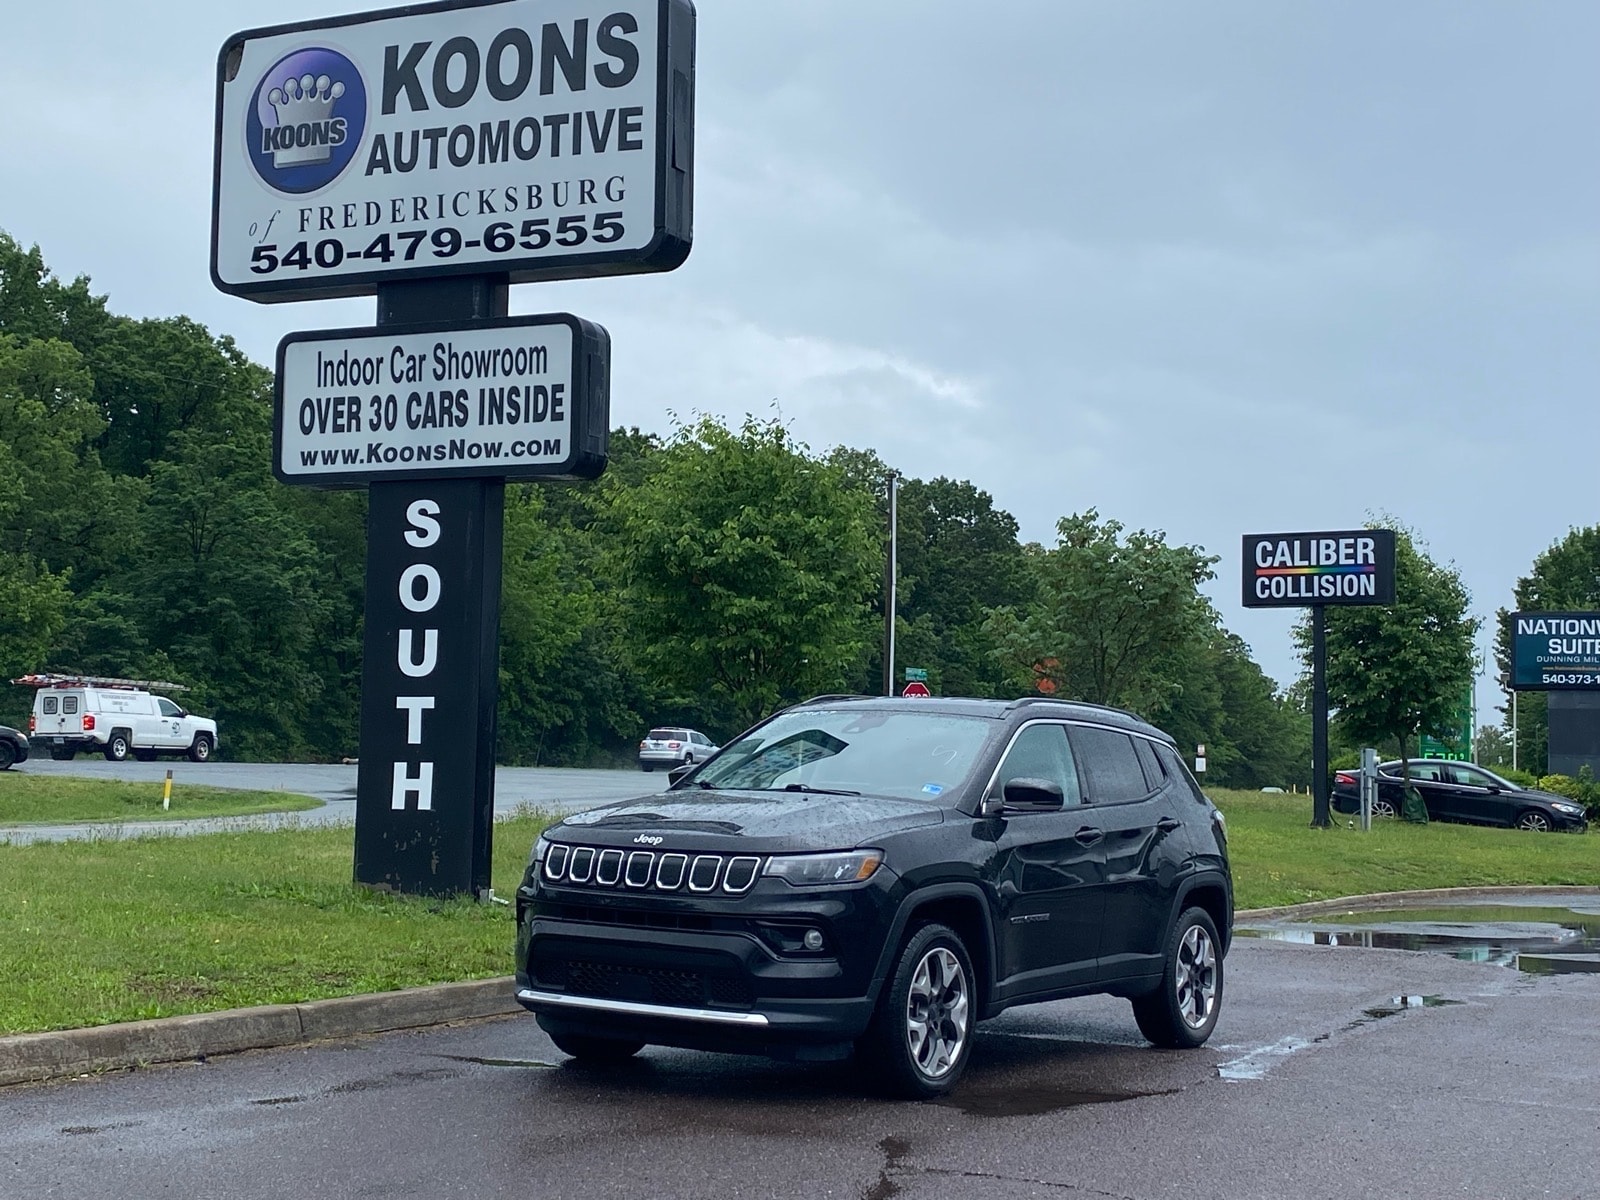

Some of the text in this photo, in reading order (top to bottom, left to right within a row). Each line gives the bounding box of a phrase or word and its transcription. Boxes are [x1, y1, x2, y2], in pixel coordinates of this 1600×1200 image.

[381, 11, 640, 116] KOONS
[263, 119, 347, 152] KOONS
[364, 106, 644, 177] AUTOMOTIVE
[248, 175, 626, 244] of FREDERICKSBURG
[249, 211, 625, 274] 540-479-6555
[317, 342, 548, 388] Indoor Car Showroom
[299, 384, 565, 436] OVER 30 CARS INSIDE
[1255, 537, 1376, 568] CALIBER
[1255, 573, 1376, 599] COLLISION
[391, 499, 441, 811] SOUTH
[1536, 655, 1581, 664] DUNNING
[633, 833, 664, 846] Jeep
